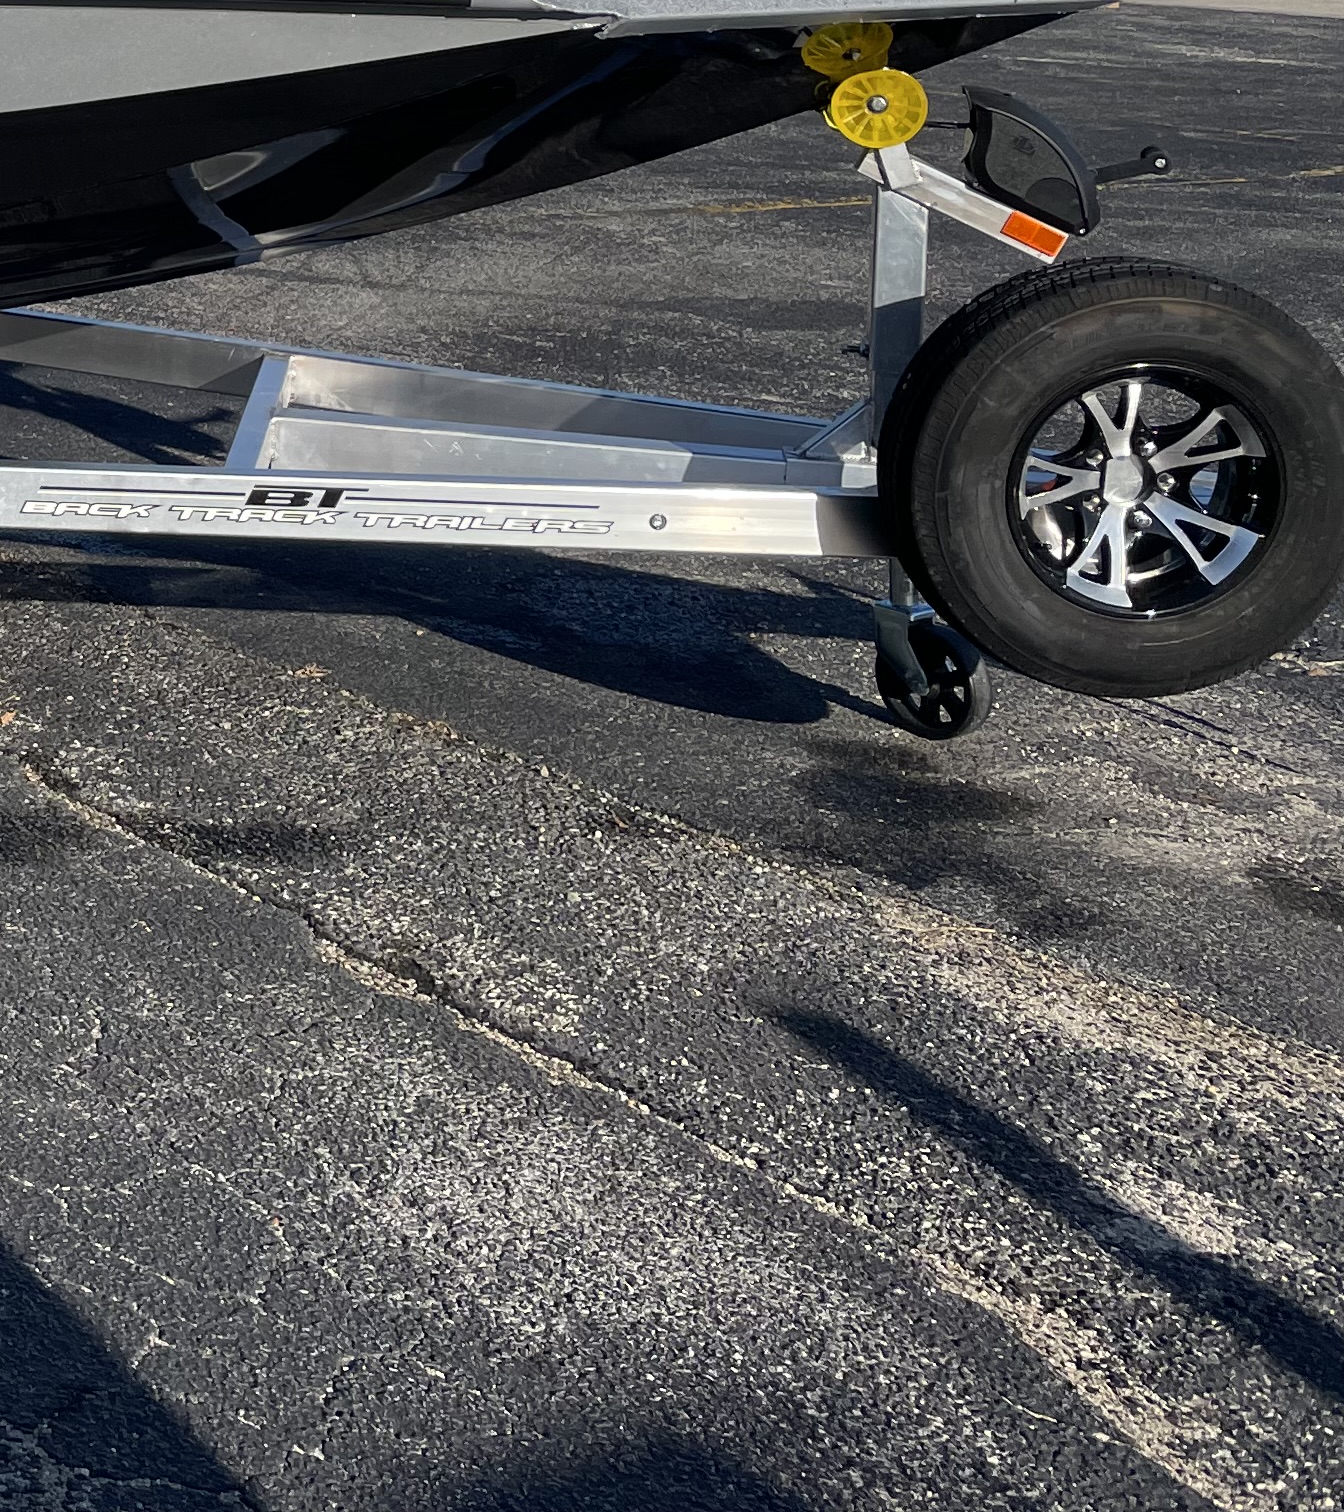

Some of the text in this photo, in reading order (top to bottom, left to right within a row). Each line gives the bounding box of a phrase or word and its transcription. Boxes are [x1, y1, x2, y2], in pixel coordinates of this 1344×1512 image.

[20, 499, 615, 535] BACK TRACK TRAILERS
